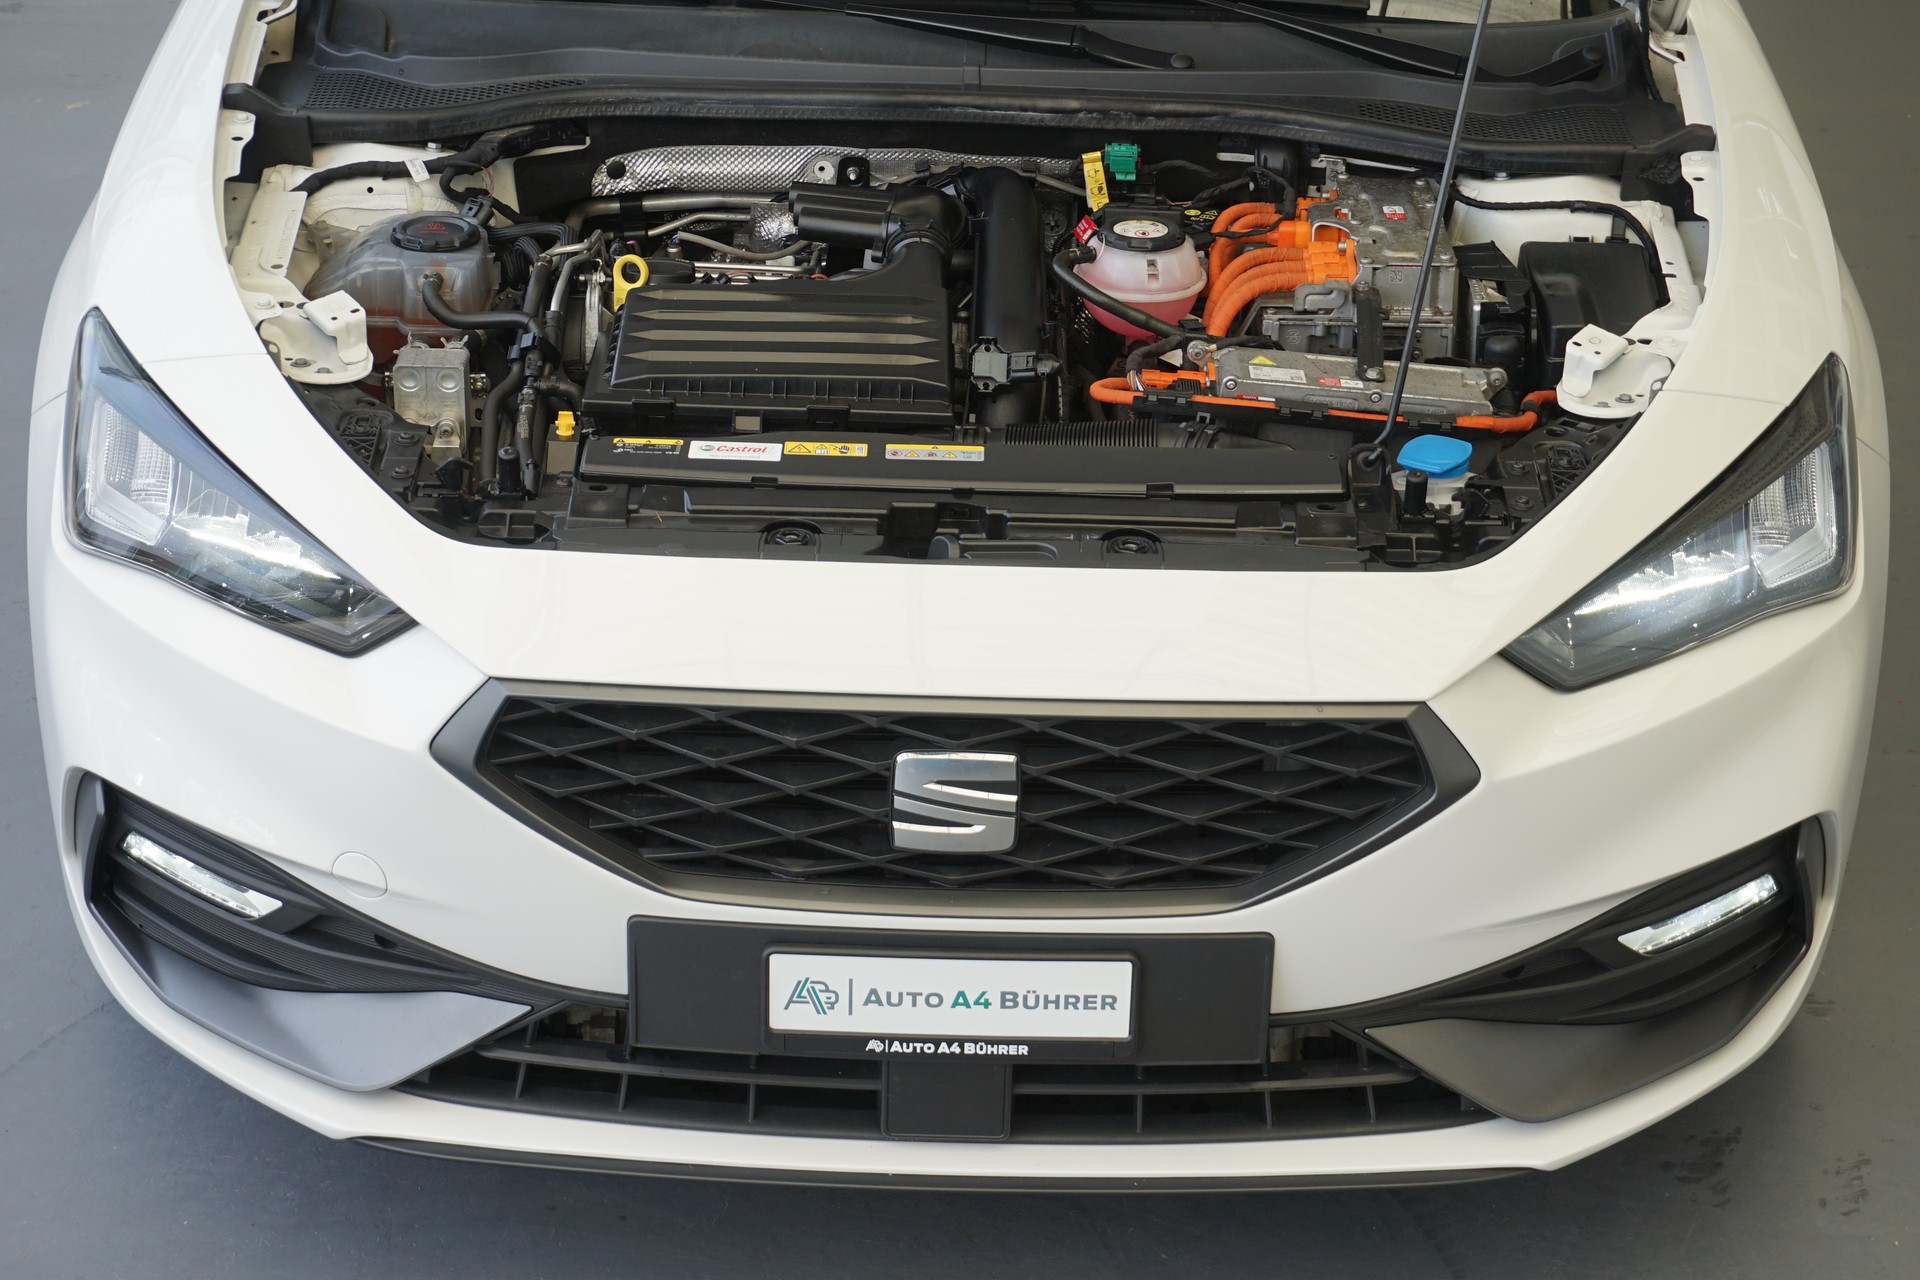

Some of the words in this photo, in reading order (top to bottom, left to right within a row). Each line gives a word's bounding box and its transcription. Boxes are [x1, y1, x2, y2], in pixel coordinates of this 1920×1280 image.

[716, 445, 767, 453] Castrol
[862, 988, 944, 1008] AUTO
[950, 990, 992, 1009] A4
[1000, 990, 1118, 1010] BÜHRER
[937, 1042, 961, 1054] A4
[964, 1042, 1029, 1056] BÜHRER
